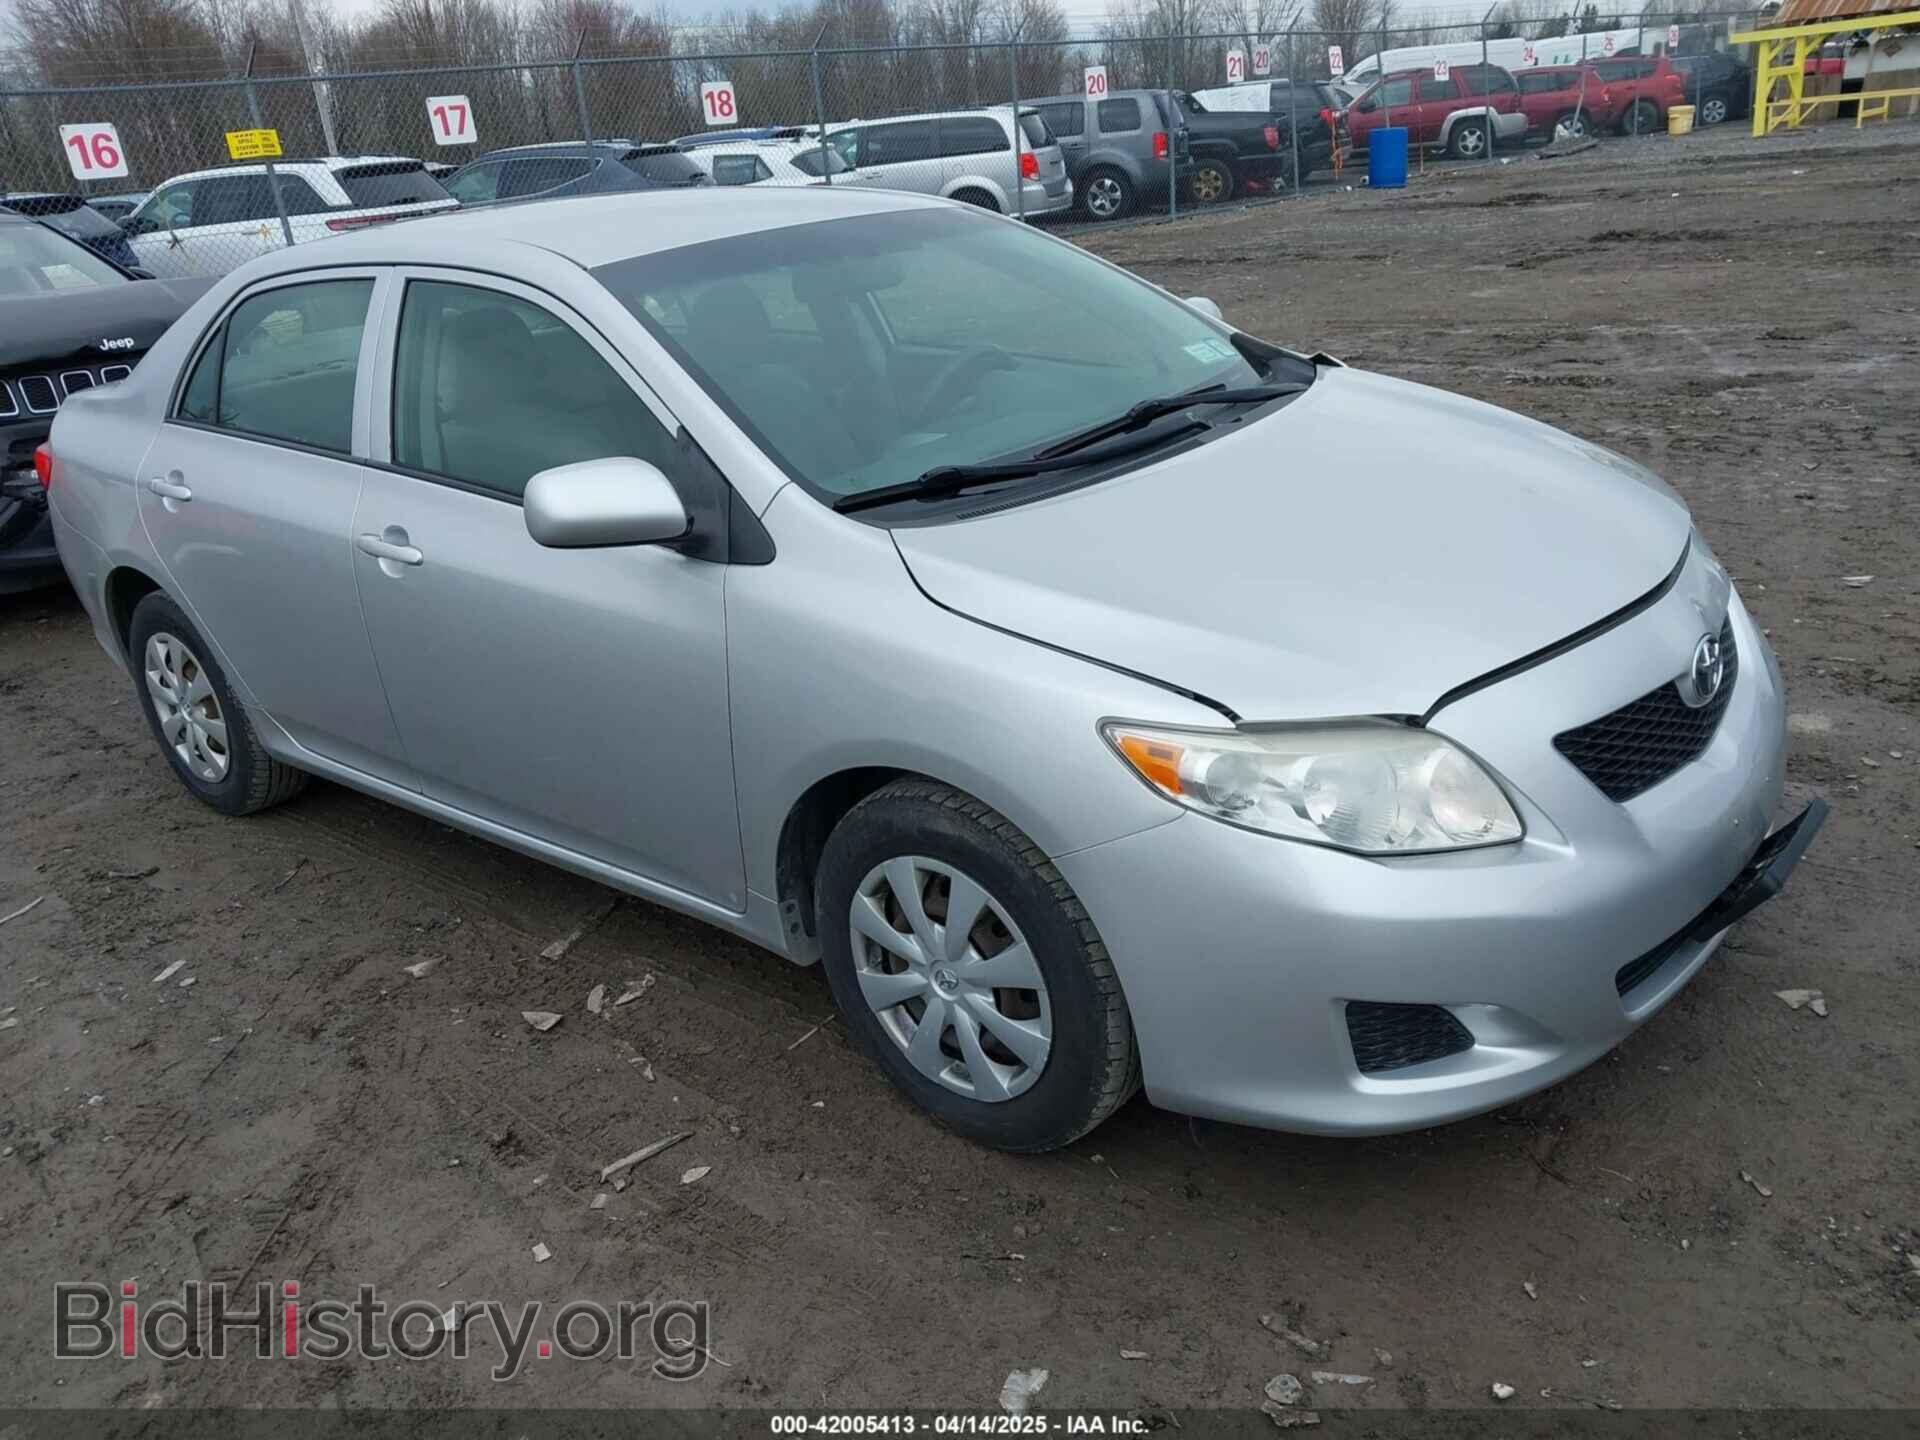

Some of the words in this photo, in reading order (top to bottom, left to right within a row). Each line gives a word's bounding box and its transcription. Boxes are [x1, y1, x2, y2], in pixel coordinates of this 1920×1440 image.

[1255, 50, 1269, 69] 20
[1330, 53, 1342, 69] 22
[1523, 46, 1535, 62] 24
[1228, 56, 1243, 77] 21
[1087, 73, 1105, 95] 20
[705, 90, 734, 117] 18
[433, 103, 466, 136] 17
[68, 133, 119, 168] 16
[99, 336, 135, 351] Jeep
